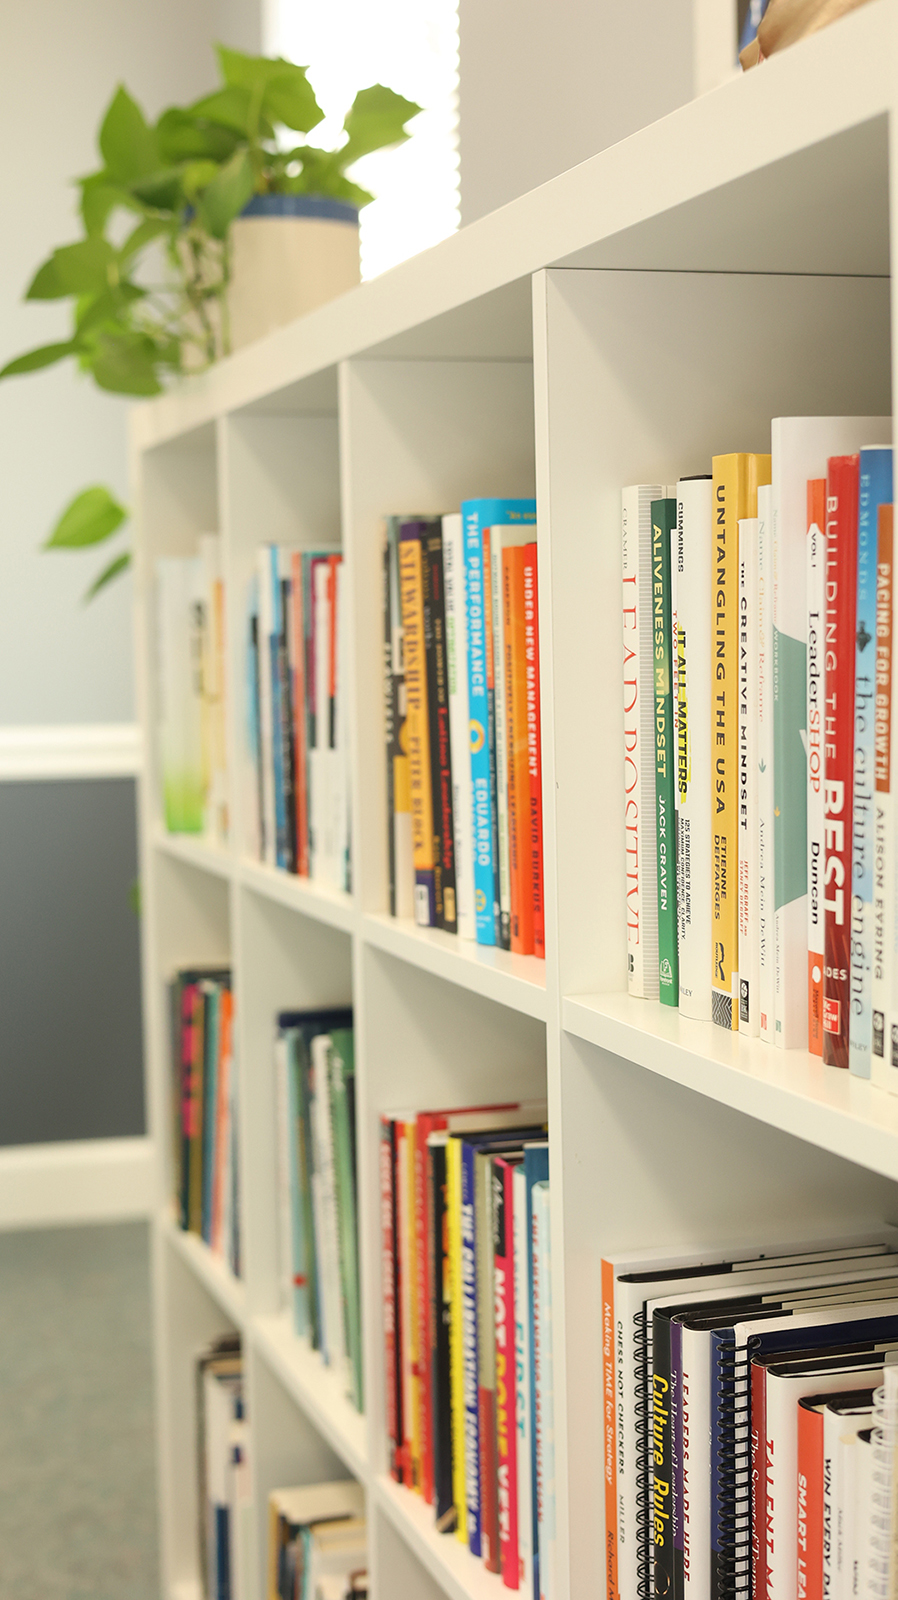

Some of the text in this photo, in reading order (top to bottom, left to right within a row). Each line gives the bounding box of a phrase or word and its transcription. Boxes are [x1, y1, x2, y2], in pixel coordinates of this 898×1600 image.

[859, 474, 870, 600] EDMONDS
[467, 512, 485, 698] THE PERFORMANCE
[653, 524, 666, 778] ALIVENESS MINDSET
[716, 485, 726, 815] UNTANGLING THE USA
[402, 546, 424, 850] STEWARDSHIP PETER BLOCK
[506, 643, 514, 715] POSITIVELY
[673, 711, 678, 729] IN
[677, 630, 689, 795] IT ALL MATTERS
[809, 610, 820, 793] LeaderSHOP
[824, 496, 846, 926] BUILDING THE BEST
[874, 564, 890, 781] PACING FOR GROWTH
[507, 717, 516, 791] ENERGIZING
[523, 566, 541, 913] UNDER NEW MANAGEMENT DAVID BURKUS
[440, 769, 453, 869] Leadership
[475, 778, 491, 867] EDUARDO
[510, 795, 518, 870] LEADERSHIP
[624, 728, 639, 944] POSITIVE
[659, 795, 668, 912] JACK CRAVEN
[850, 676, 873, 1018] the culture engine
[685, 881, 691, 890] TO
[811, 841, 821, 925] Duncan
[874, 807, 885, 980] ALISON EYRING
[824, 966, 847, 981] DES
[462, 1204, 475, 1243] THE
[462, 1246, 478, 1409] COLLABORATION
[494, 1267, 507, 1349] NOT
[603, 1302, 614, 1486] Making TIME for Strategy
[670, 1369, 678, 1398] The
[653, 1373, 669, 1548] Culture Rules
[824, 1457, 832, 1497] WIN
[607, 1530, 615, 1585] Richard
[797, 1472, 807, 1600] SMART LEA
[824, 1501, 832, 1568] EVERY
